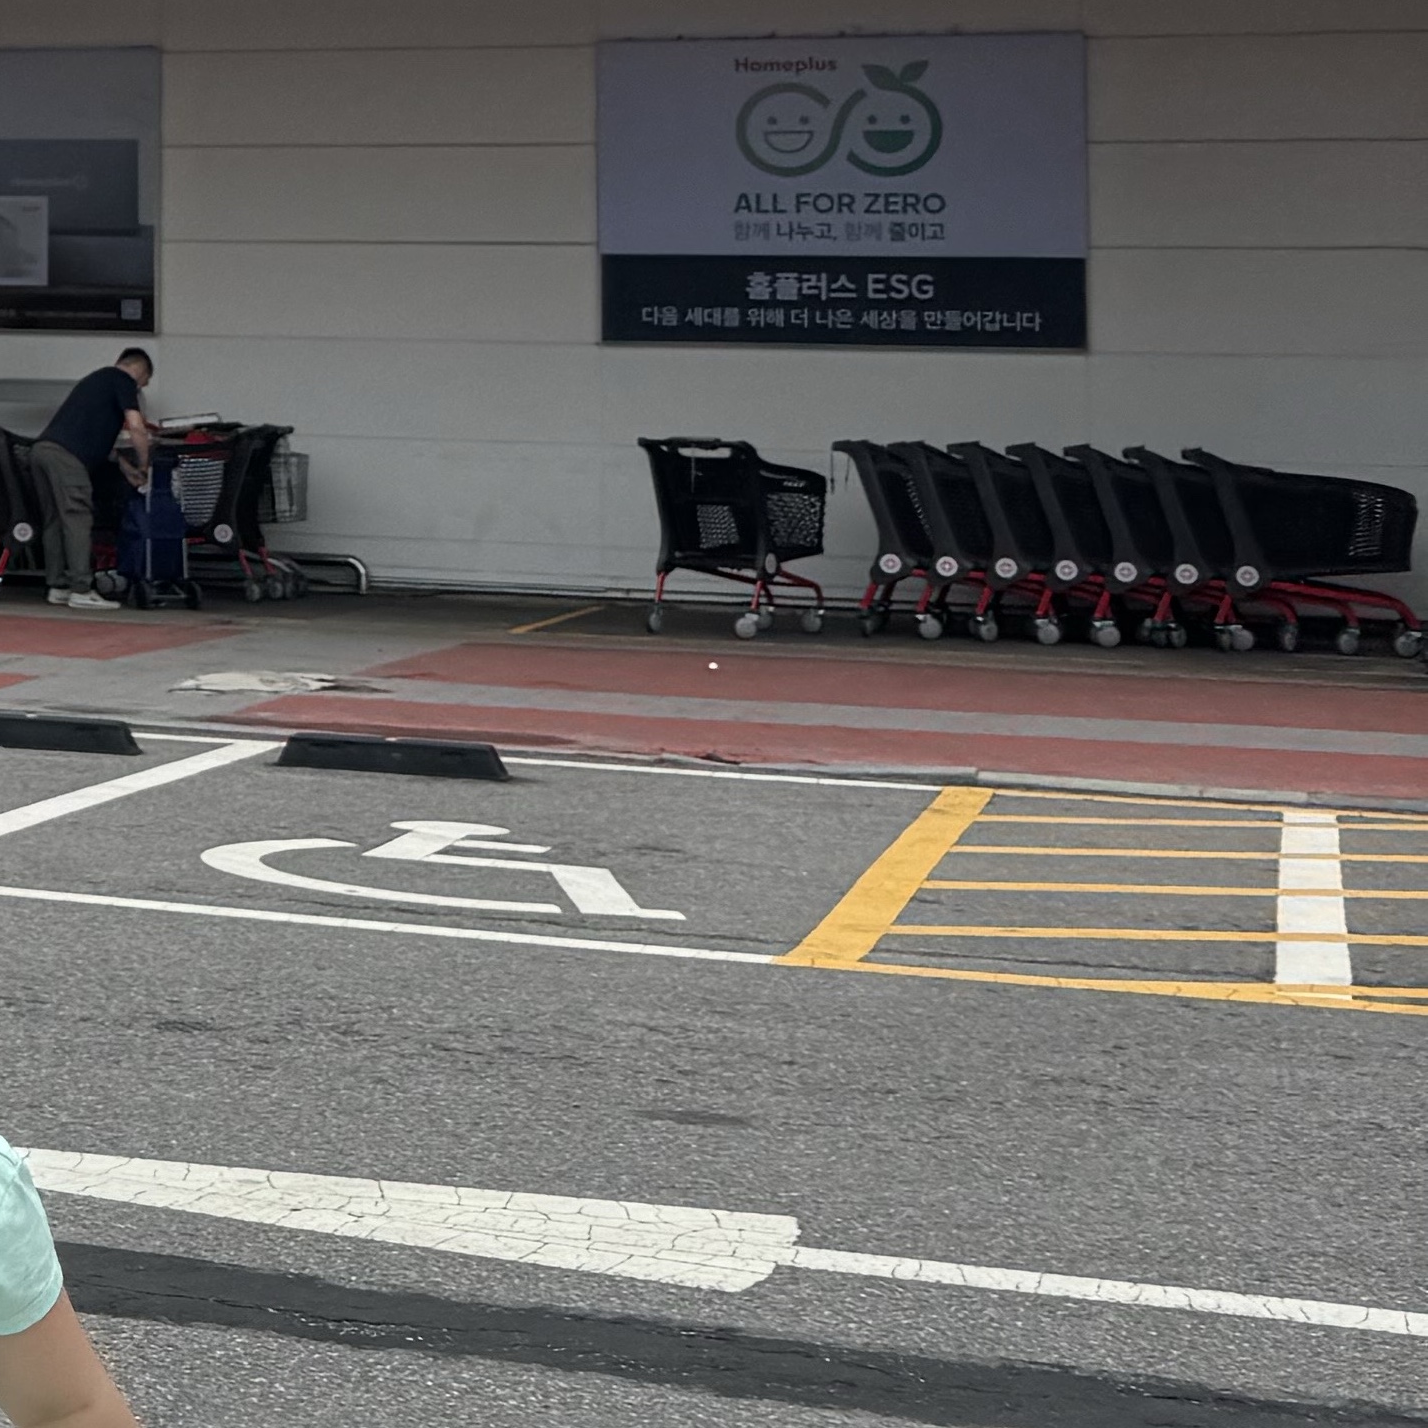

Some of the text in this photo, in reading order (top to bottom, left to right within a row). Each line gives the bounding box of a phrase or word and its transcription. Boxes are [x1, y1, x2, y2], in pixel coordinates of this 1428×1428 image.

[734, 57, 838, 76] Homeplus
[734, 192, 946, 215] ALL FOR ZERO
[734, 221, 770, 241] 함께
[845, 221, 882, 241] 함께
[890, 221, 945, 242] 줄이고
[746, 272, 934, 300] 홈플러스 ESG
[642, 308, 1042, 332] 다음 세대를 위해 더 나은 세상을 만들어갑니다
